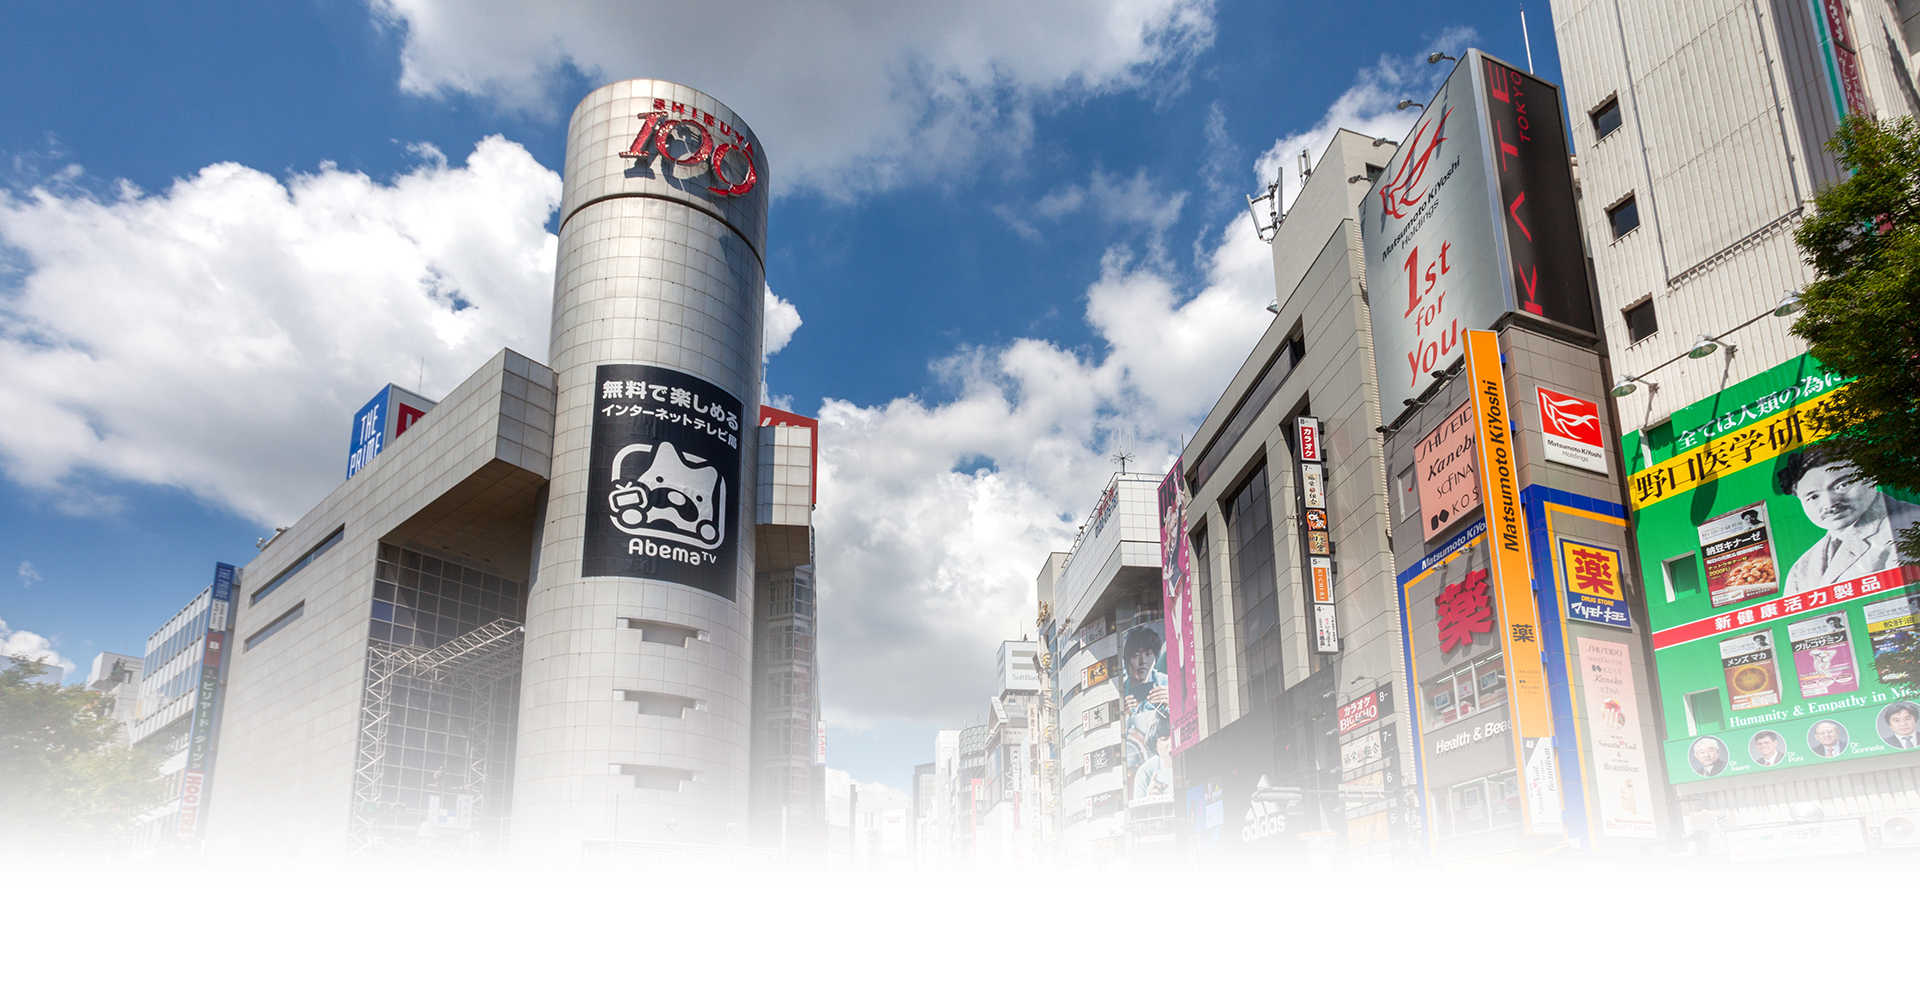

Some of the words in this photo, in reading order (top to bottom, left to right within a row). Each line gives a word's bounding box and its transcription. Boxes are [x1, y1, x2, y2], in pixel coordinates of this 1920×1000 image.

[1511, 71, 1531, 143] TOKYO
[653, 98, 754, 157] SHIBUYA
[619, 111, 758, 196] 109
[1382, 201, 1427, 261] Matsumoto
[1427, 155, 1461, 203] KiYoshi
[1401, 199, 1440, 250] Holdings
[1404, 239, 1452, 320] 1st
[1415, 291, 1446, 337] for
[603, 380, 739, 431] 無料で楽しめる
[1483, 380, 1505, 445] KiYoshi
[360, 404, 380, 445] THE
[601, 404, 738, 450] インターネットテレビ局
[1417, 406, 1473, 464] SHISEID
[348, 432, 382, 479] PRIME
[1303, 428, 1314, 457] カラオケ
[1547, 439, 1581, 454] Matsumoto
[1580, 446, 1602, 459] KiYoshi
[1562, 450, 1589, 463] Holdings
[1451, 486, 1480, 516] KOS
[1496, 448, 1520, 552] Matsumoto
[1421, 531, 1466, 570] Matsumoto
[1706, 531, 1762, 556] 納豆キナーゼ
[1572, 548, 1615, 596] 薬
[1435, 568, 1495, 654] 薬
[1571, 601, 1627, 623] マツモトキヨシ
[1581, 595, 1597, 604] DRUG
[1597, 598, 1614, 607] STORE
[1715, 575, 1882, 631] 新健康活力製品
[1511, 624, 1535, 642] 薬
[1794, 635, 1844, 652] グルコサミン
[1586, 645, 1623, 657] SHISEIDO
[1727, 655, 1750, 667] メンズ
[1750, 652, 1767, 660] マカ
[1594, 674, 1624, 686] Kanebo
[1340, 715, 1356, 731] BIG
[1355, 704, 1377, 721] ECHO
[1344, 696, 1371, 717] カラオケ
[1729, 709, 1789, 728] Humanity
[1792, 705, 1805, 717] &
[1808, 694, 1868, 714] Empathy
[1873, 691, 1887, 703] in
[1436, 731, 1471, 755] Health
[1472, 727, 1482, 741] &
[1485, 719, 1512, 738] Beau
[1525, 740, 1535, 749] 4F
[1598, 740, 1621, 749] Sweetie
[1622, 742, 1637, 750] Nail
[1851, 745, 1885, 754] Gonnella
[1545, 748, 1556, 792] Beautilism
[1604, 762, 1639, 773] Beautilism
[1730, 764, 1750, 772] Asano
[1788, 755, 1805, 763] Pohl
[178, 774, 202, 837] HOOTERS
[1093, 805, 1113, 815] BAGUS
[1242, 814, 1286, 843] adidas
[1606, 820, 1632, 831] BEAUTY
[1633, 824, 1654, 832] SALON
[1781, 827, 1823, 841] 渋谷駅
[1517, 874, 1549, 883] Matsumoto
[1549, 872, 1572, 880] KiYoshi
[1602, 872, 1639, 880] Matsumot
